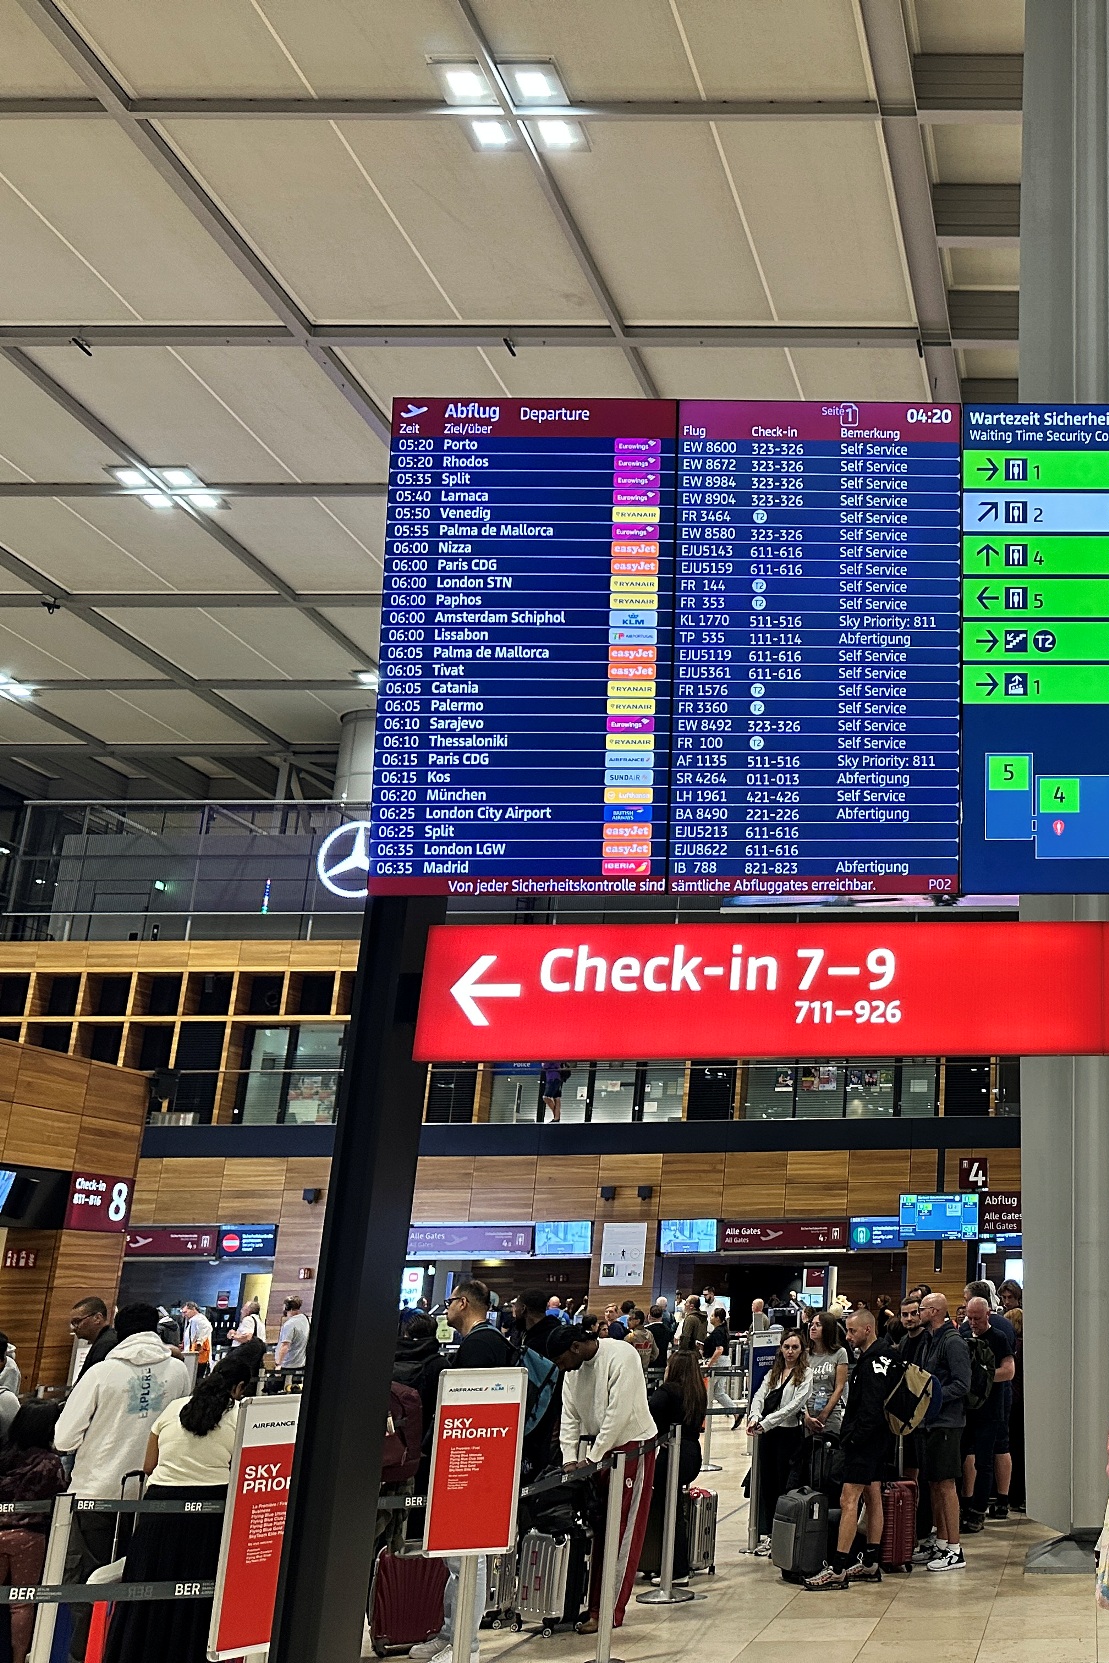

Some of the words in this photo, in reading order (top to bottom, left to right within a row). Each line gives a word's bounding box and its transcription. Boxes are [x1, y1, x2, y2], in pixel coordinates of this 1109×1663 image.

[444, 403, 500, 422] Abflug
[520, 407, 590, 423] Departure
[821, 406, 845, 416] Seite
[846, 408, 853, 422] 1
[906, 409, 952, 423] 04:20
[969, 412, 1040, 426] Wartezeit
[400, 424, 420, 434] Zeit
[444, 423, 492, 435] Ziel/über
[683, 426, 707, 438] Flug
[751, 426, 798, 438] Check-in
[840, 428, 901, 441] Bemerkung
[969, 430, 1013, 443] Waiting
[1015, 430, 1043, 441] Time
[1046, 431, 1092, 444] Security
[398, 439, 434, 450] 05:20
[443, 439, 478, 450] Porto
[683, 442, 702, 453] EW
[706, 442, 737, 453] 8600
[751, 443, 804, 455] 323-326
[840, 444, 862, 456] Self
[866, 444, 908, 456] Service
[1033, 465, 1041, 480] 1
[1033, 508, 1044, 523] 2
[1033, 550, 1045, 566] 4
[1033, 593, 1044, 608] 5
[1036, 635, 1053, 648] T2
[1033, 680, 1041, 694] 1
[1003, 764, 1014, 781] 5
[1053, 787, 1065, 803] 4
[376, 862, 413, 874] 06:35
[423, 861, 469, 874] Madrid
[604, 862, 636, 870] IBERIA
[674, 863, 686, 874] IB
[693, 862, 717, 874] 788
[744, 862, 798, 874] 821-823
[835, 861, 909, 876] Abfertigung
[448, 880, 473, 892] Von
[475, 879, 508, 893] jeder
[511, 878, 637, 892] Sicherheitskontrolle
[639, 878, 666, 891] sind
[671, 879, 731, 892] sämtliche
[734, 879, 809, 893] Abfluggates
[811, 879, 876, 892] erreichbar.
[928, 879, 952, 890] P02
[539, 944, 778, 993] Check-in
[969, 1162, 986, 1186] 4
[75, 1178, 107, 1192] Check-in
[108, 1182, 128, 1222] 8
[984, 1195, 1018, 1207] Abflug
[984, 1212, 1000, 1220] Alle
[984, 1222, 994, 1230] All
[995, 1222, 1017, 1230] Gates
[425, 1232, 445, 1240] Gates
[252, 1421, 296, 1429] AIRFRANCE
[443, 1418, 473, 1429] SKY
[442, 1427, 509, 1439] PRIORITY
[244, 1463, 282, 1479] SKY
[77, 1500, 95, 1510] BER
[184, 1502, 202, 1512] BER
[405, 1497, 423, 1506] BER
[9, 1587, 36, 1600] BER
[174, 1583, 200, 1596] BER
